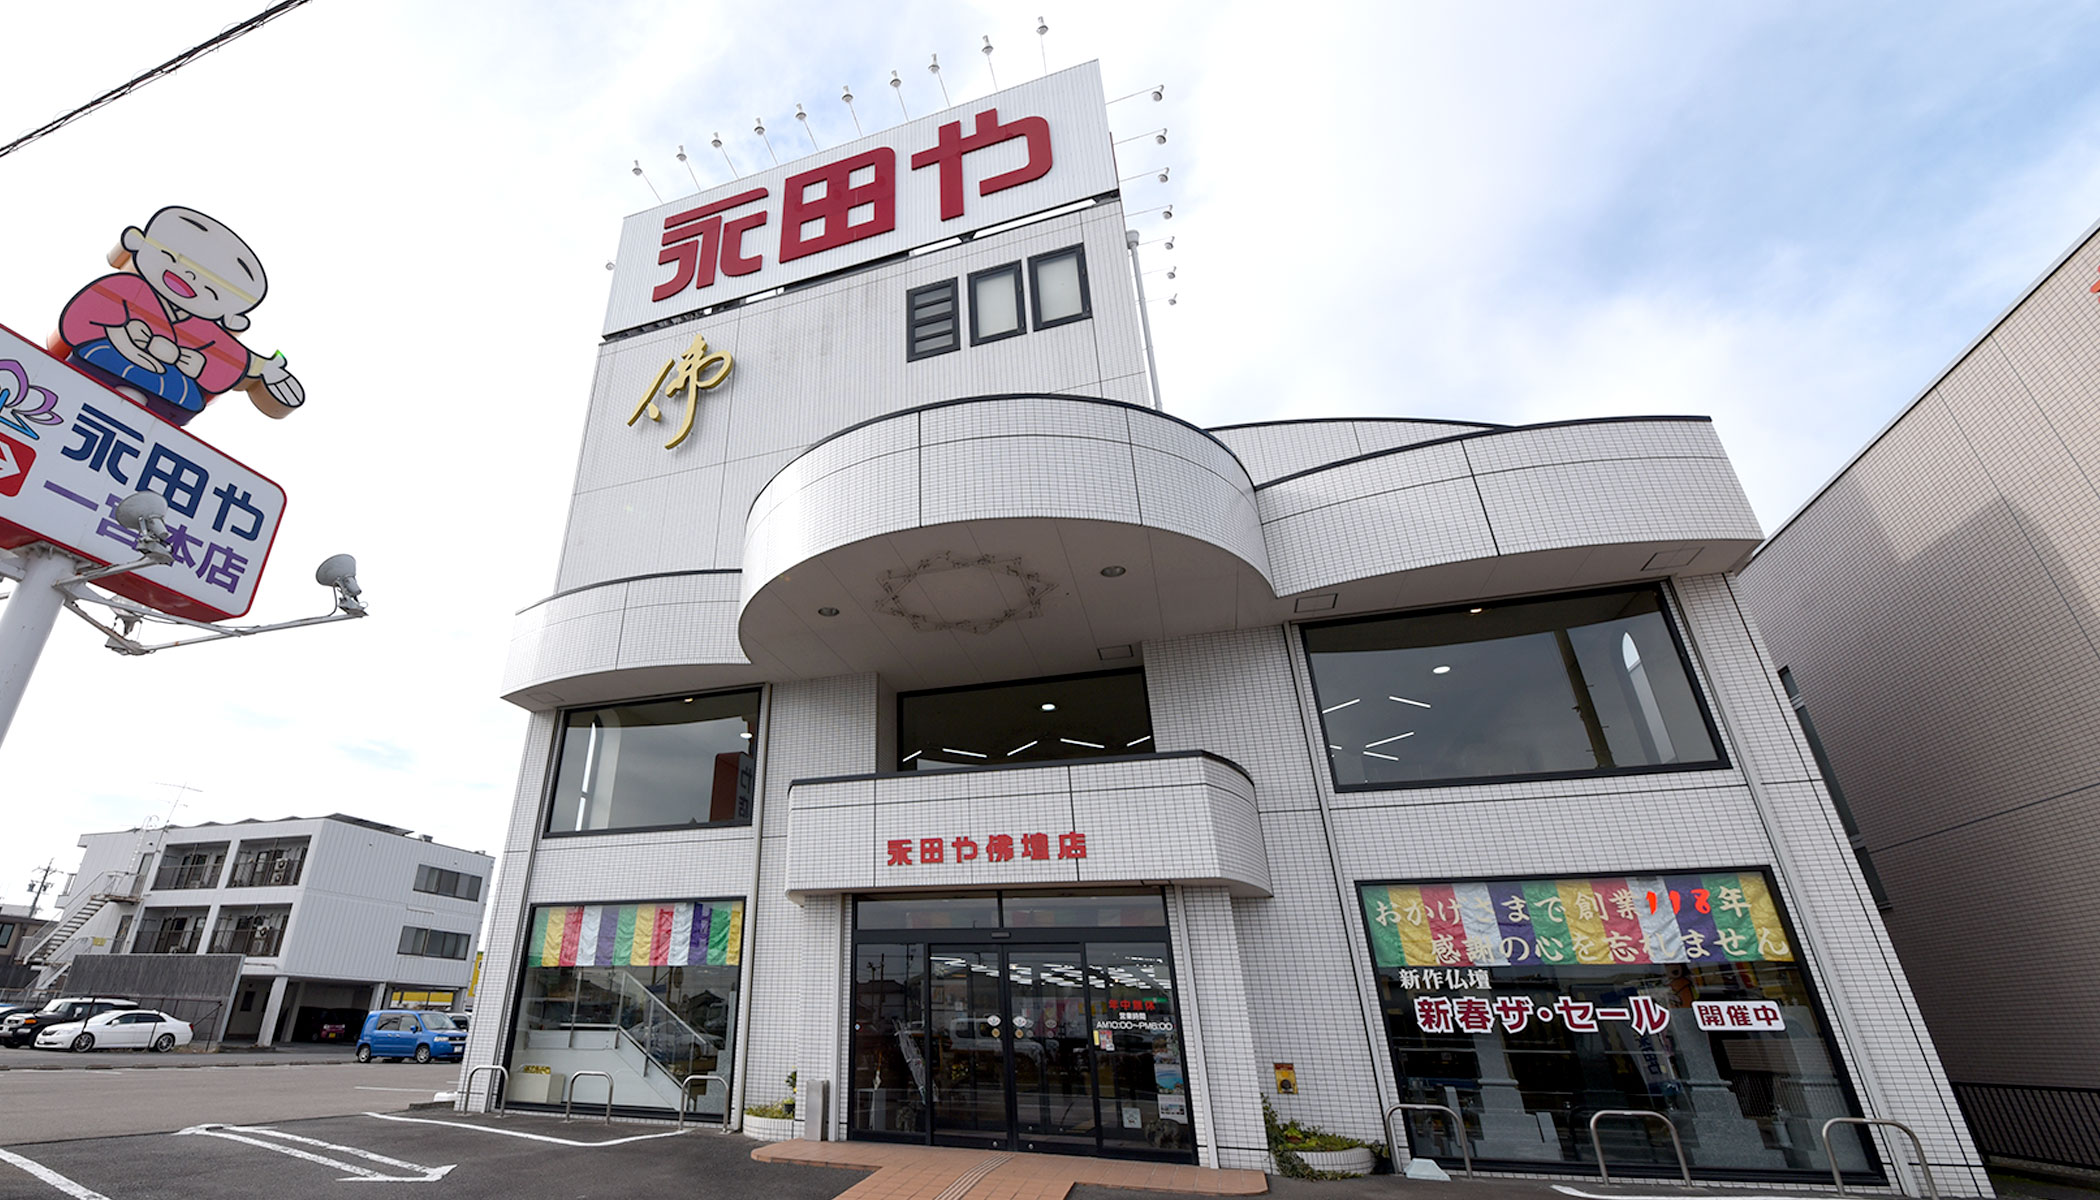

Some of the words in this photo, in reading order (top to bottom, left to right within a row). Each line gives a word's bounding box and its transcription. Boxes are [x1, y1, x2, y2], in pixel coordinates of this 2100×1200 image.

[653, 109, 1052, 301] 永田や
[61, 403, 264, 541] 永田や
[888, 832, 1086, 866] 永田や佛壇店
[1432, 927, 1789, 964] 感謝の心を忘れません
[1399, 969, 1492, 990] 新作仏壇
[1108, 1000, 1156, 1011] 年中無休
[1415, 995, 1669, 1035] 新春ザ・セール
[1697, 1003, 1782, 1028] 開催中
